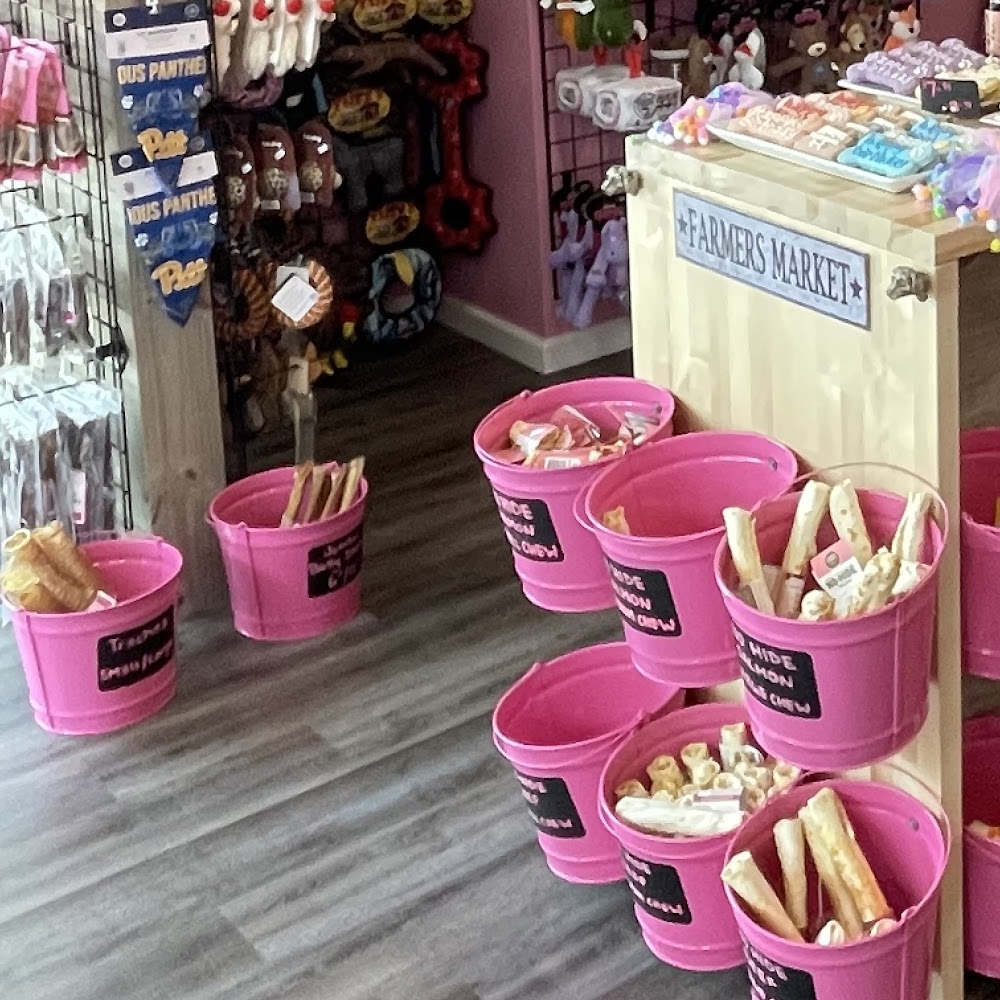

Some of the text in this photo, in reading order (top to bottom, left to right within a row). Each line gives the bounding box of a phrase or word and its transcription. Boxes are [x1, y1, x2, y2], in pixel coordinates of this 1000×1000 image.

[688, 208, 850, 305] FARMERS MARKET
[748, 641, 798, 672] HIDE
[769, 692, 811, 715] CHEW
